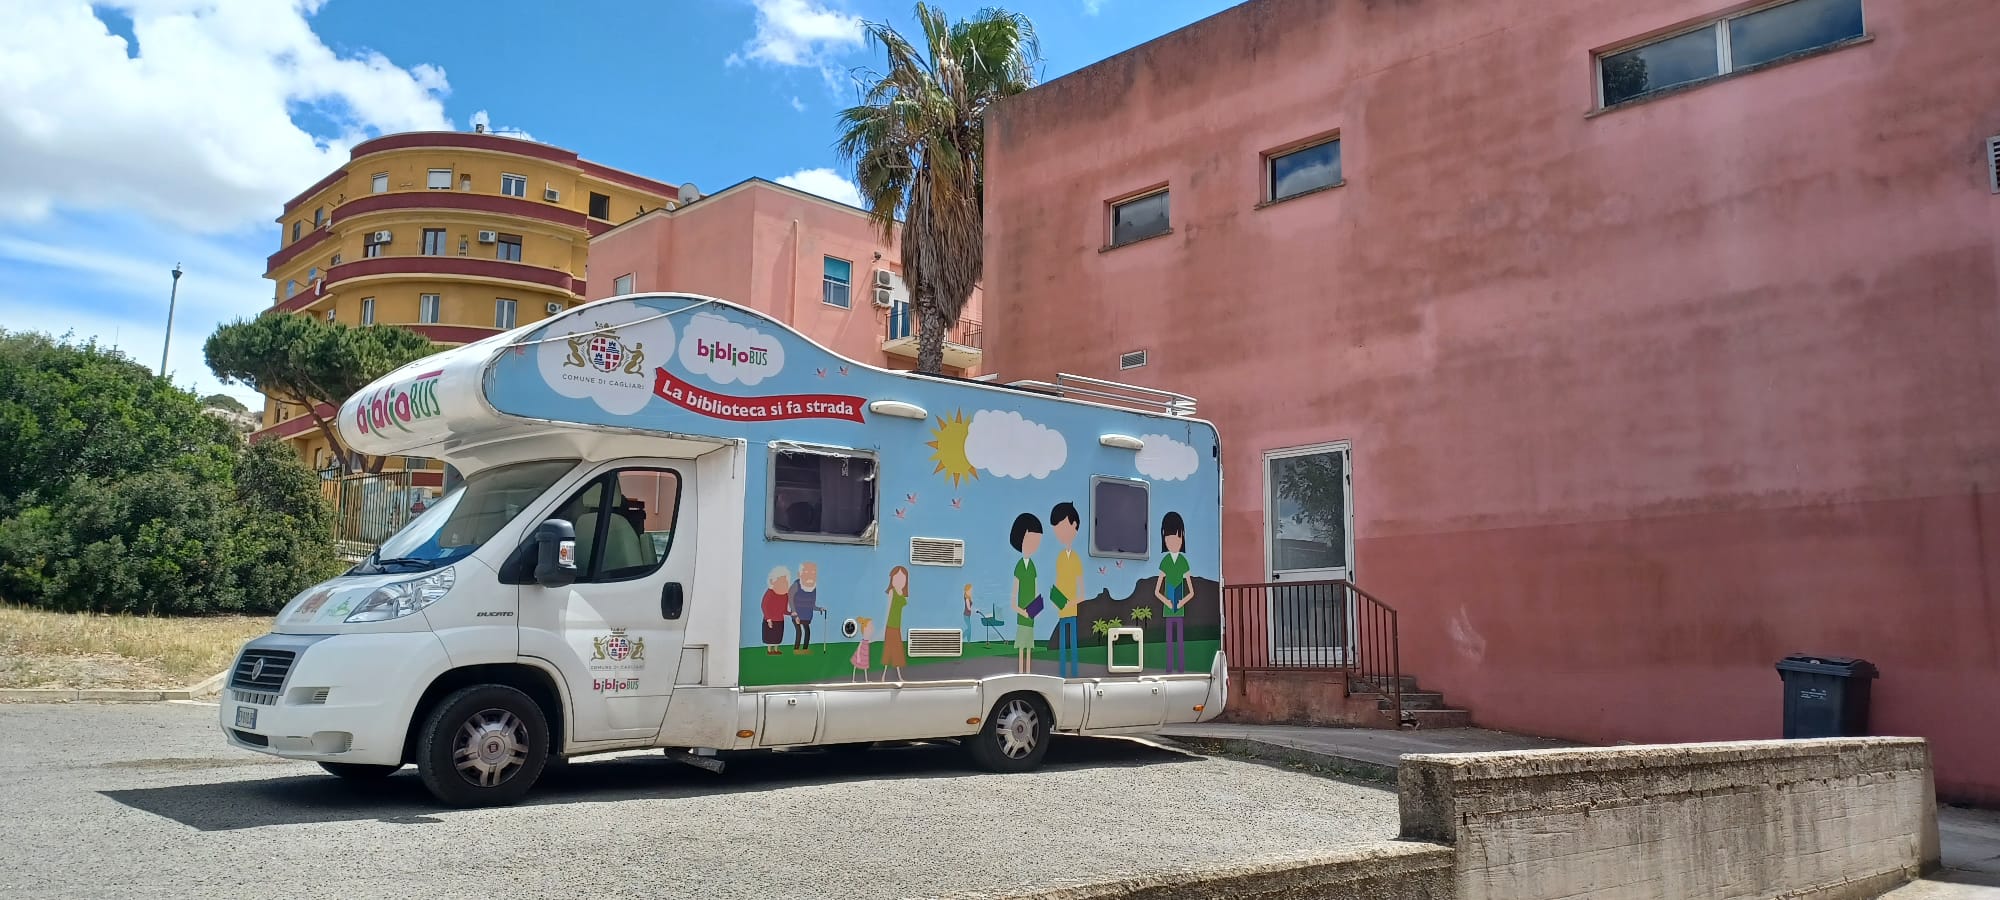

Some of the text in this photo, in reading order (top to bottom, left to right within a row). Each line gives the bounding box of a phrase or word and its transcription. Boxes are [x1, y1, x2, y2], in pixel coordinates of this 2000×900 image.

[562, 373, 595, 384] COMUNE
[609, 380, 645, 390] CAGLIARI
[662, 379, 854, 416] La biblioteca si fa strada
